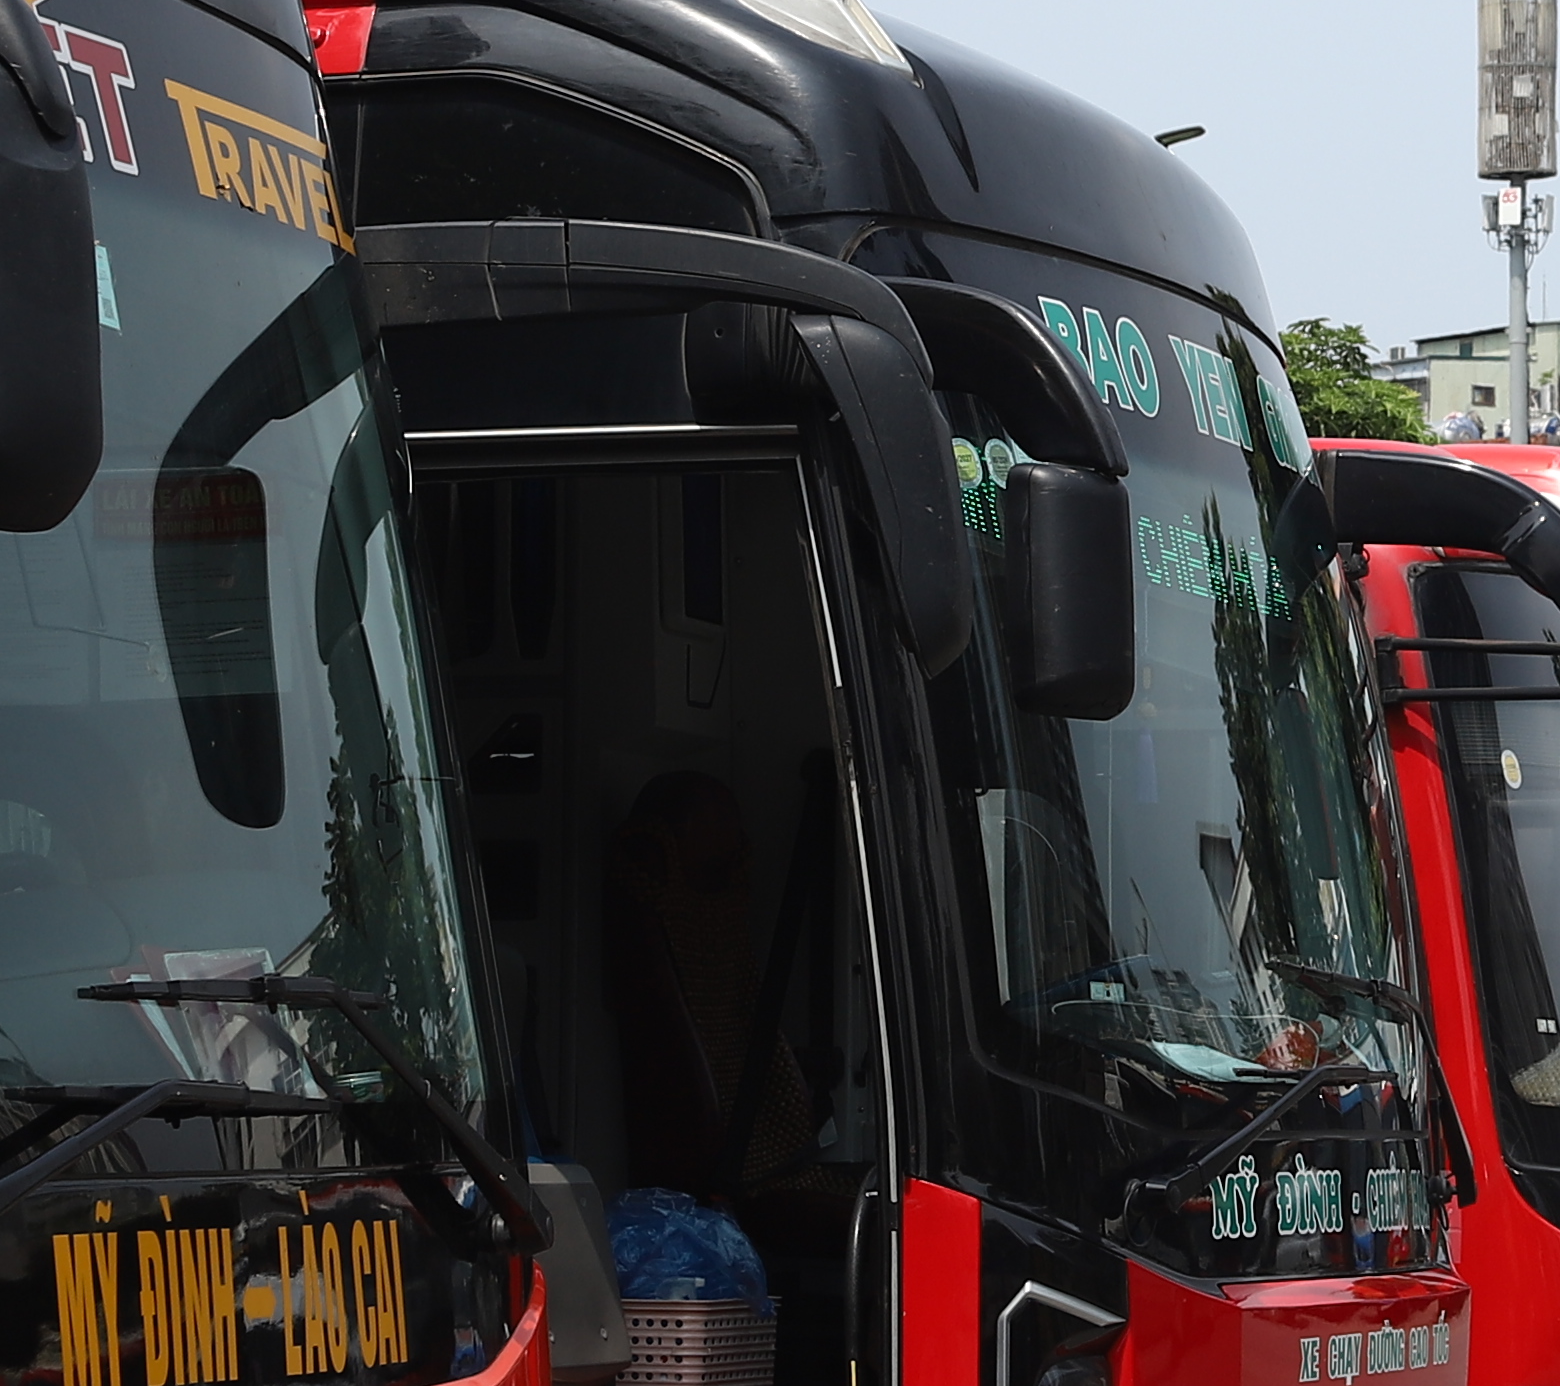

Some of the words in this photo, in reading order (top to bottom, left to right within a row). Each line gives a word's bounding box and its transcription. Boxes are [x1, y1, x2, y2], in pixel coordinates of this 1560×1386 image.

[164, 78, 357, 256] TRAVEL
[1210, 1155, 1260, 1240] MỸ
[1275, 1153, 1344, 1236] ĐÌNH
[278, 1190, 348, 1376] LÀO
[351, 1219, 408, 1369] CAI
[1299, 1337, 1320, 1382] XE
[1328, 1333, 1362, 1386] CHẠY
[1410, 1327, 1429, 1370] CAO
